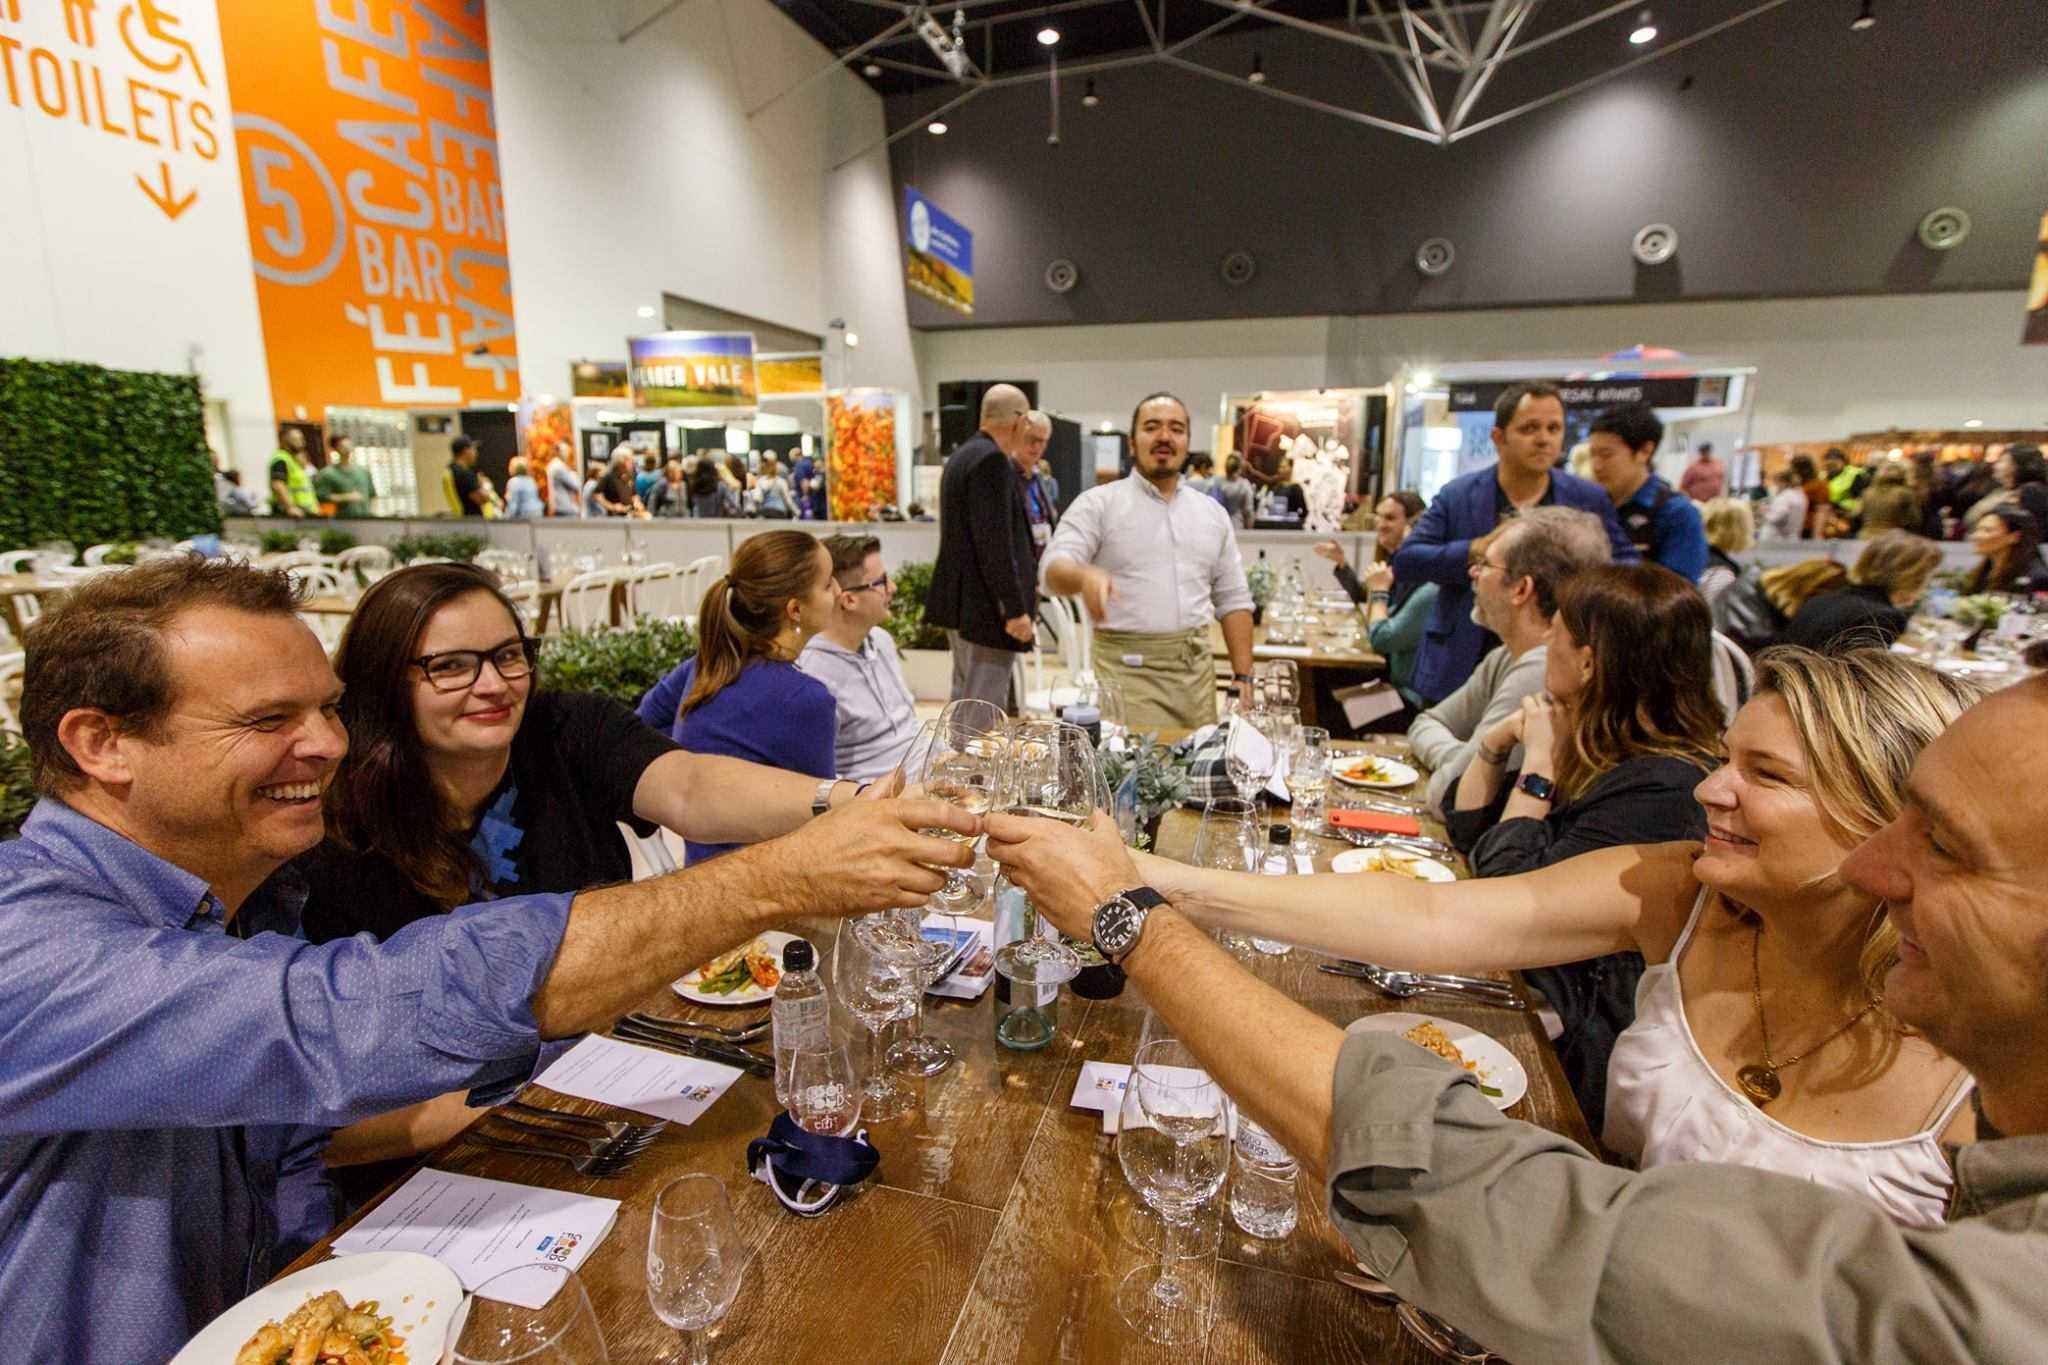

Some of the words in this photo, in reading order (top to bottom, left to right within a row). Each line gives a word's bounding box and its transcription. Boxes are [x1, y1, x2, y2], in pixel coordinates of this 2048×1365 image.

[0, 34, 218, 161] TOILETS
[250, 146, 306, 259] 5
[353, 223, 449, 306] BAR
[694, 364, 743, 386] VALE
